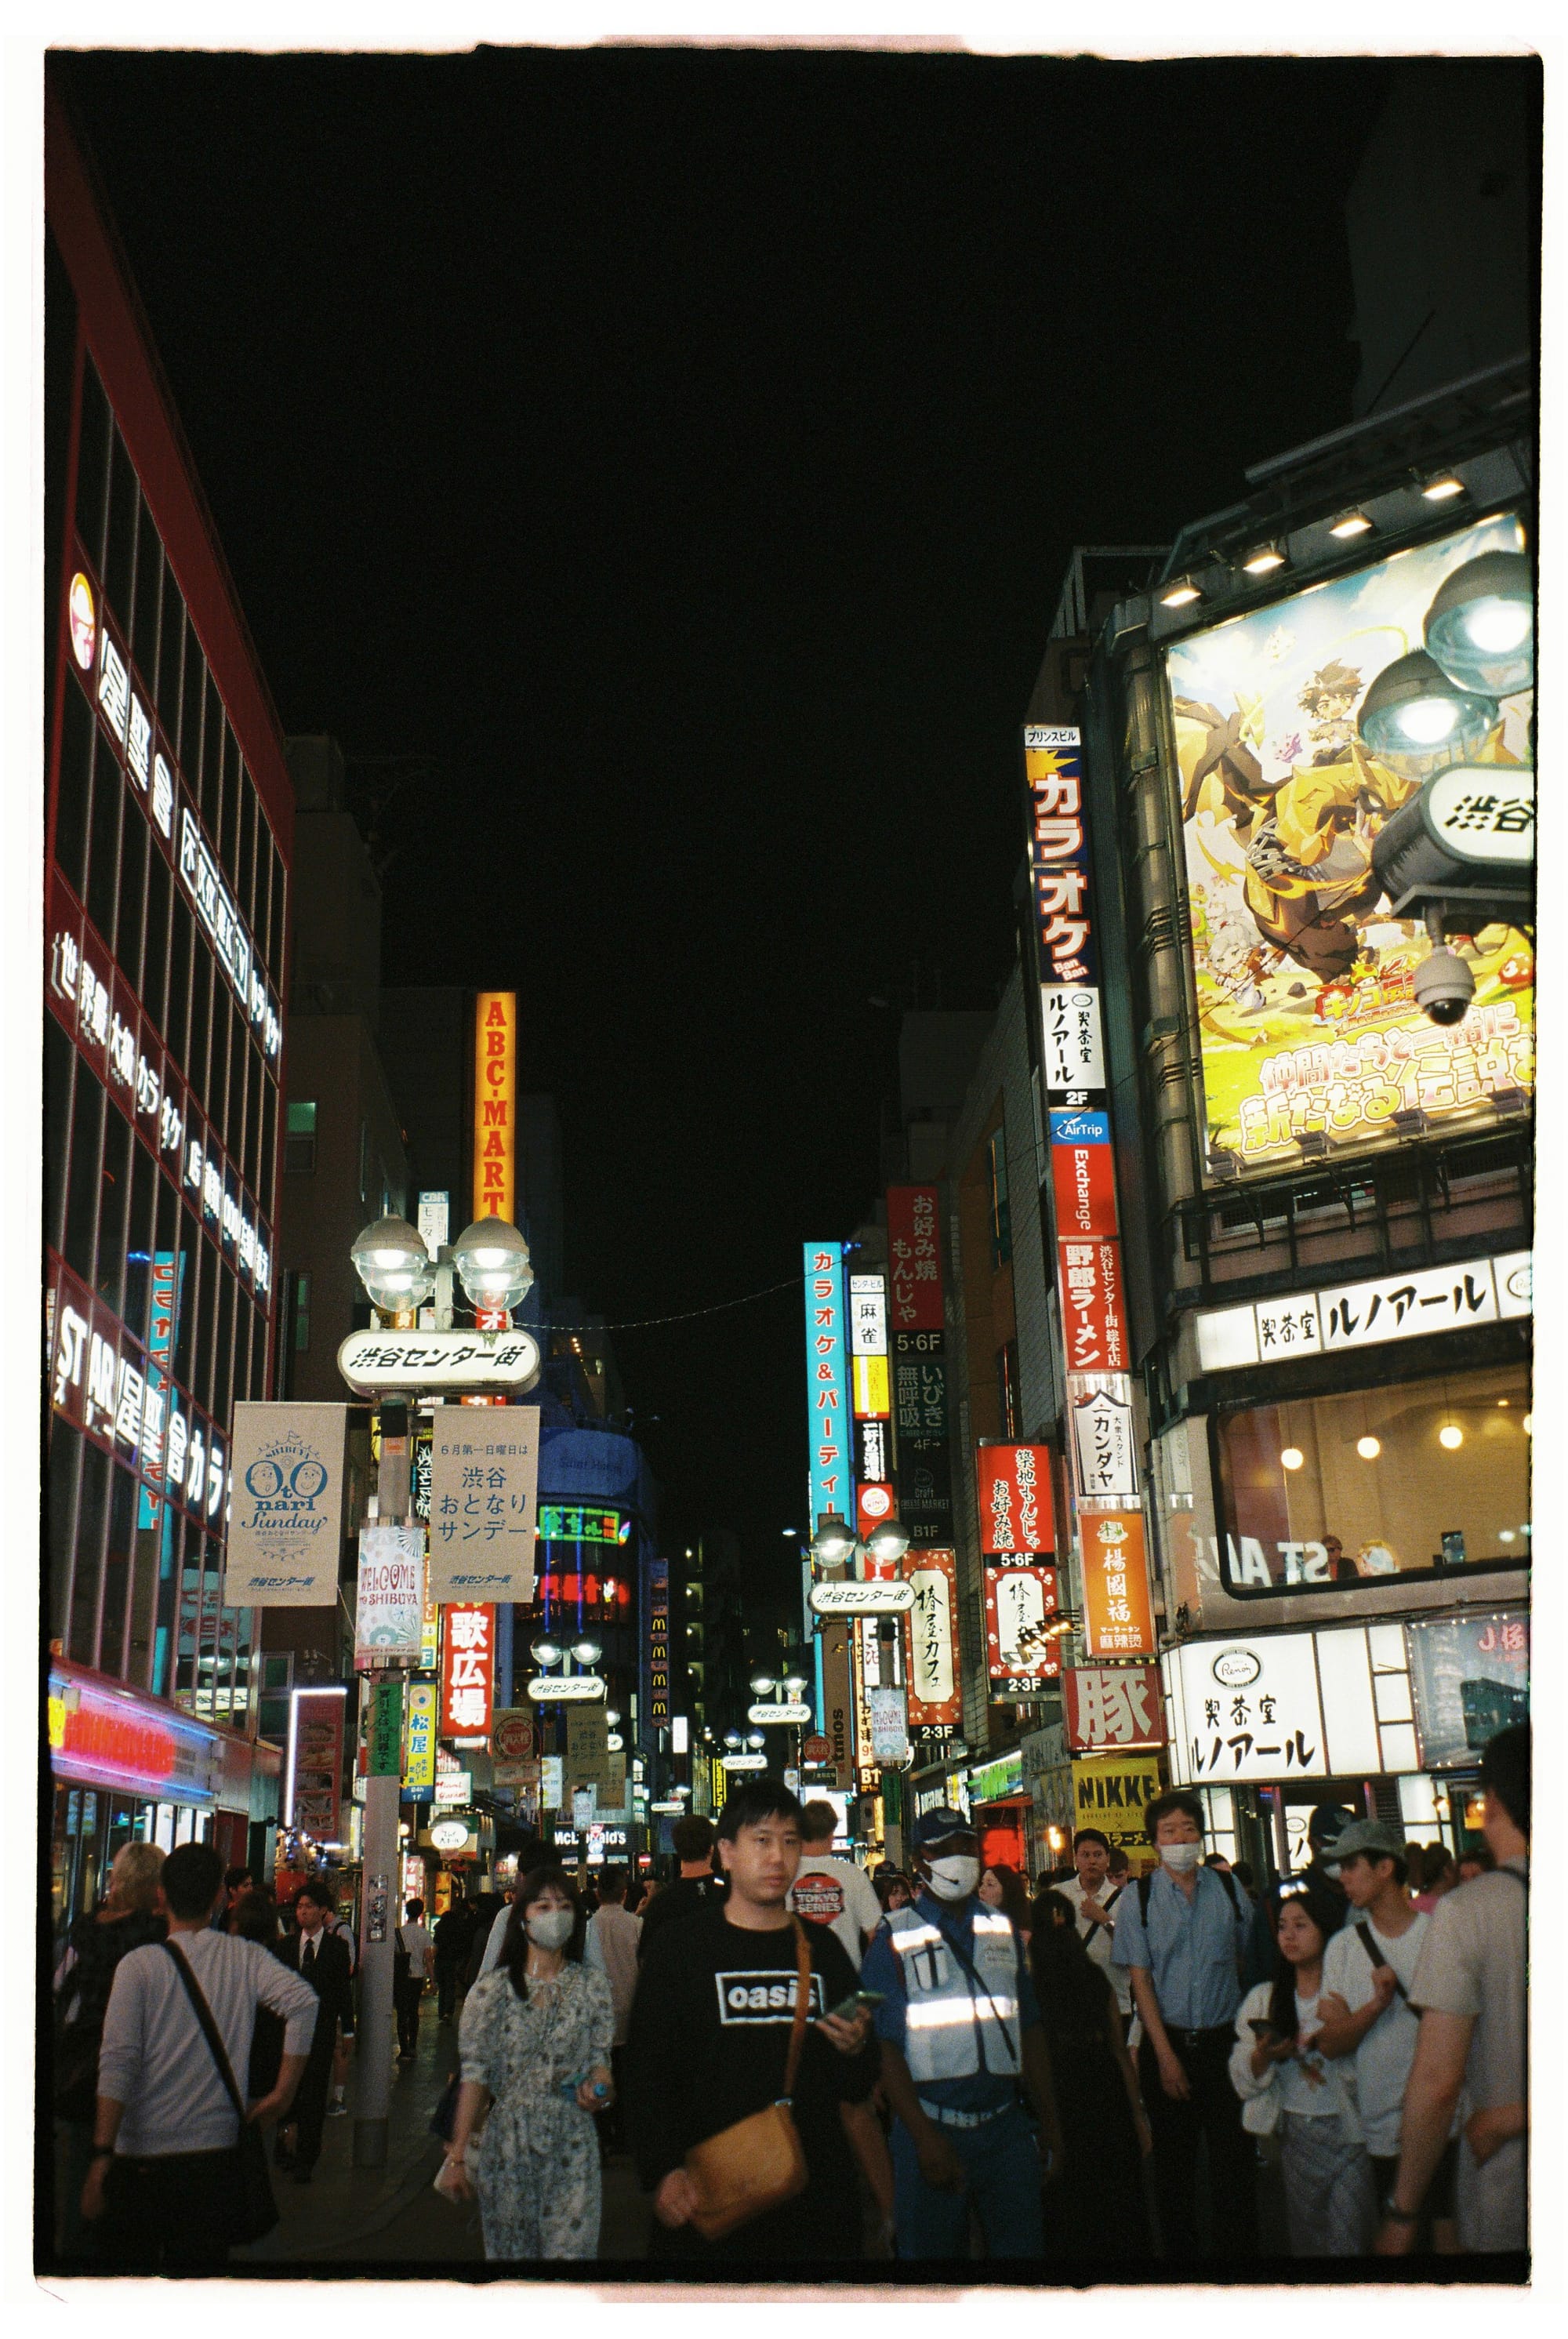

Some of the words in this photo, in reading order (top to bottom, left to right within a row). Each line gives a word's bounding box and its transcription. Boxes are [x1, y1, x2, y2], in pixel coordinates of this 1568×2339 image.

[1034, 772, 1089, 960] カラオケ
[1048, 993, 1075, 1084] ルノアール
[1077, 1011, 1094, 1064] 喫茶室
[483, 1001, 507, 1216] ABC-MART
[1065, 1091, 1087, 1106] 2F
[1064, 1122, 1103, 1137] AirTrip
[1074, 1149, 1091, 1230] Exchange
[913, 1194, 938, 1282] お好み焼
[892, 1239, 918, 1324] もんじゃ
[861, 1303, 878, 1344] 麻雀
[1065, 1244, 1101, 1367] 野郎ラーメン
[1261, 1309, 1316, 1348] 喫茶室
[1330, 1274, 1486, 1338] ルノアール
[58, 1305, 114, 1416] STAR
[350, 1346, 527, 1368] 渋谷センター街
[897, 1366, 920, 1428] 無呼吸
[923, 1365, 944, 1427] いびき
[441, 1444, 528, 1457] 6月第一日曜日は
[913, 1438, 931, 1450] 4F
[1092, 1415, 1114, 1488] カンダヤ
[462, 1466, 507, 1489] 渋谷
[1015, 1448, 1040, 1550] 築地もんじゃ
[241, 1511, 328, 1535] Sunday
[255, 1498, 316, 1511] nari
[439, 1493, 527, 1515] おとなり
[991, 1479, 1014, 1550] お好み焼
[437, 1520, 527, 1541] サンデー
[913, 1525, 939, 1538] B1F
[361, 1564, 415, 1592] WELCOME
[368, 1593, 419, 1606] SHIBUYA
[449, 1574, 514, 1585] 渋谷センター街
[818, 1589, 909, 1604] 渋谷センター街
[1102, 1547, 1131, 1622] 楊國福
[916, 1585, 945, 1687] 椿屋カフェ
[448, 1610, 488, 1729] 歌広場
[1076, 1668, 1154, 1745] 豚
[1204, 1694, 1277, 1727] 喫茶室
[410, 1712, 430, 1754] 松屋
[1192, 1730, 1316, 1775] ルノアール
[1077, 1774, 1156, 1810] NIKKE
